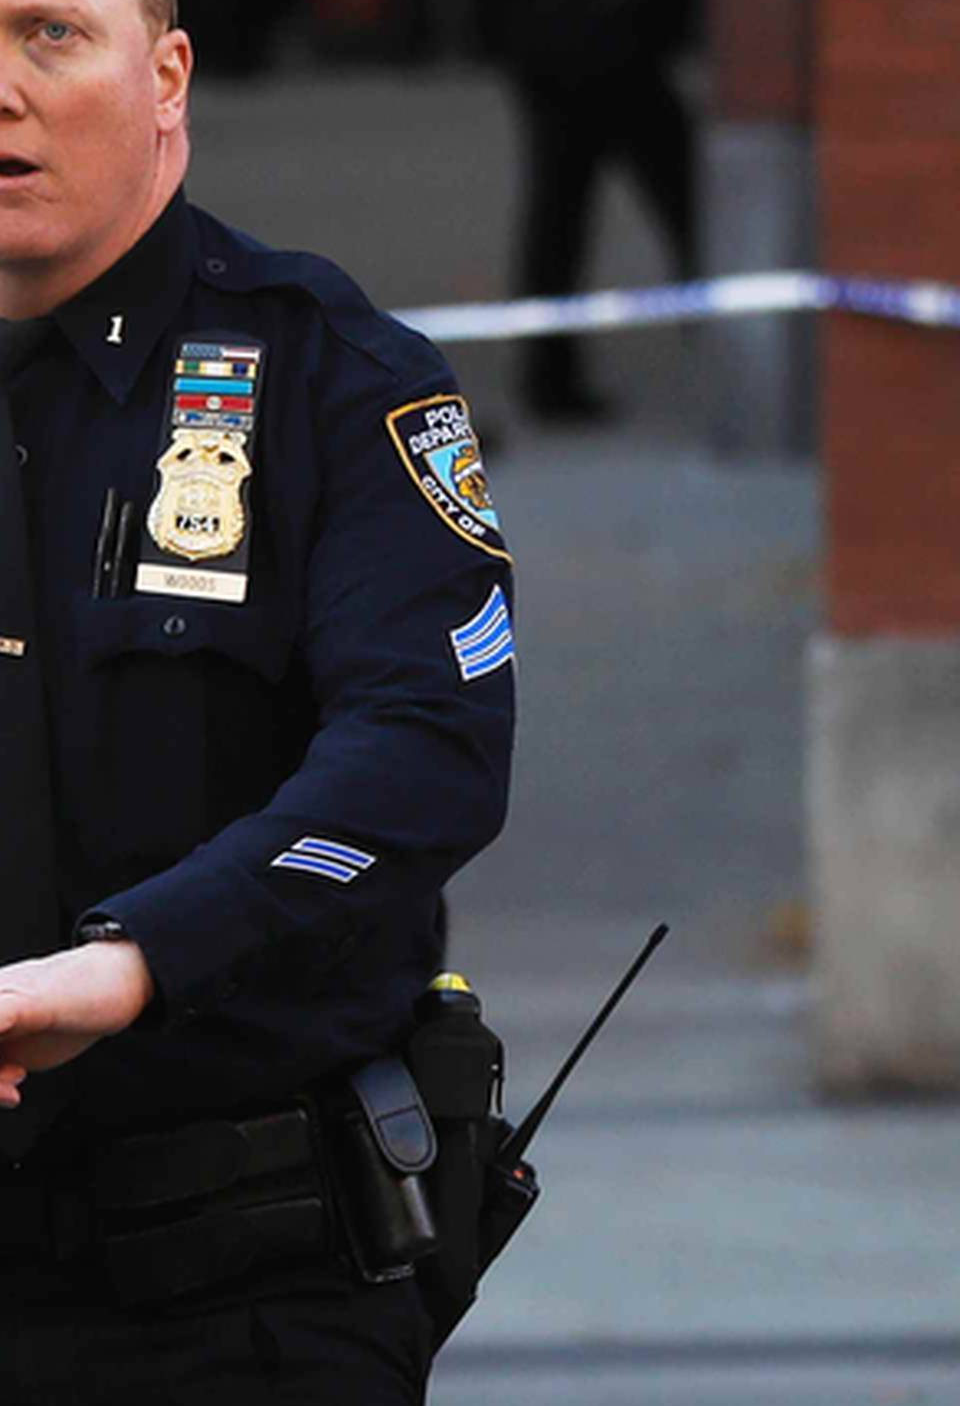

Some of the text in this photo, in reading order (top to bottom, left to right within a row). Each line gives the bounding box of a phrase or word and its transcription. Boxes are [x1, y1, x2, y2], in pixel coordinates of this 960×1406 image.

[106, 315, 122, 344] 1
[421, 474, 486, 538] CITY OF
